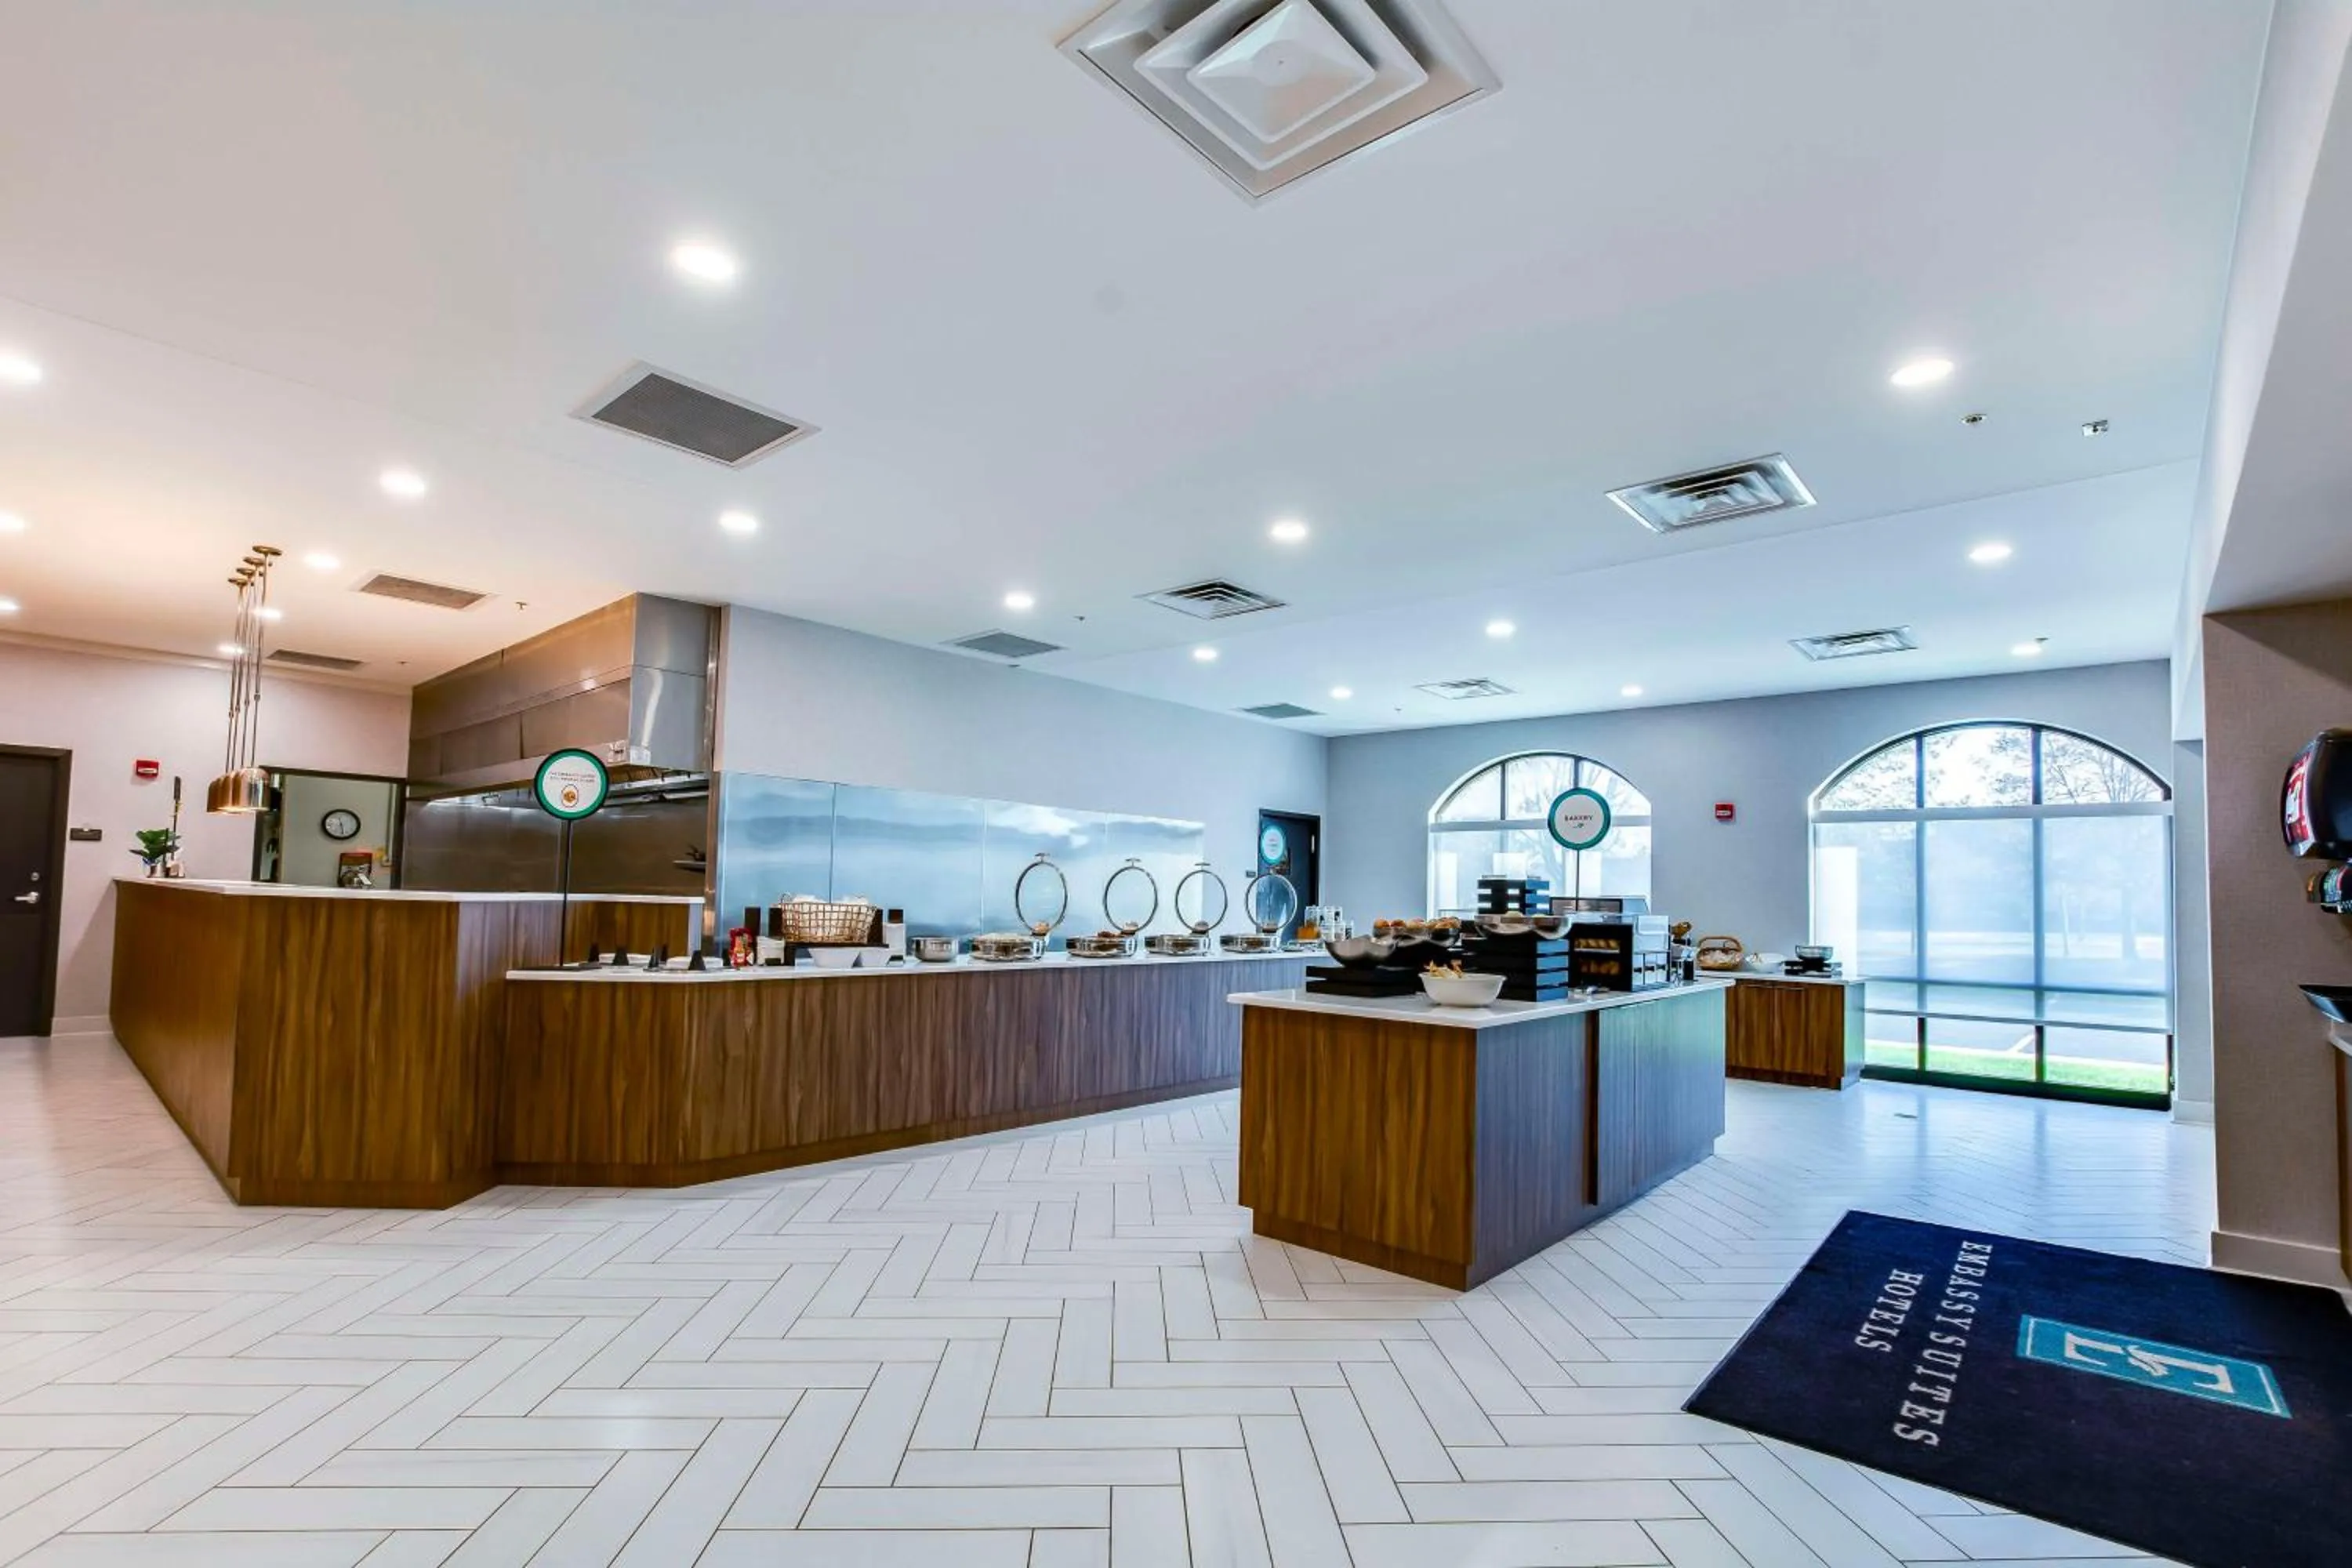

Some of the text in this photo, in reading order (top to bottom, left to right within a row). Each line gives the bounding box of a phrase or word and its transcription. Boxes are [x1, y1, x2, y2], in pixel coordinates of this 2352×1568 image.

[1853, 1268, 1925, 1352] HOTELS
[1893, 1240, 1993, 1446] EMBASSY SUITES
